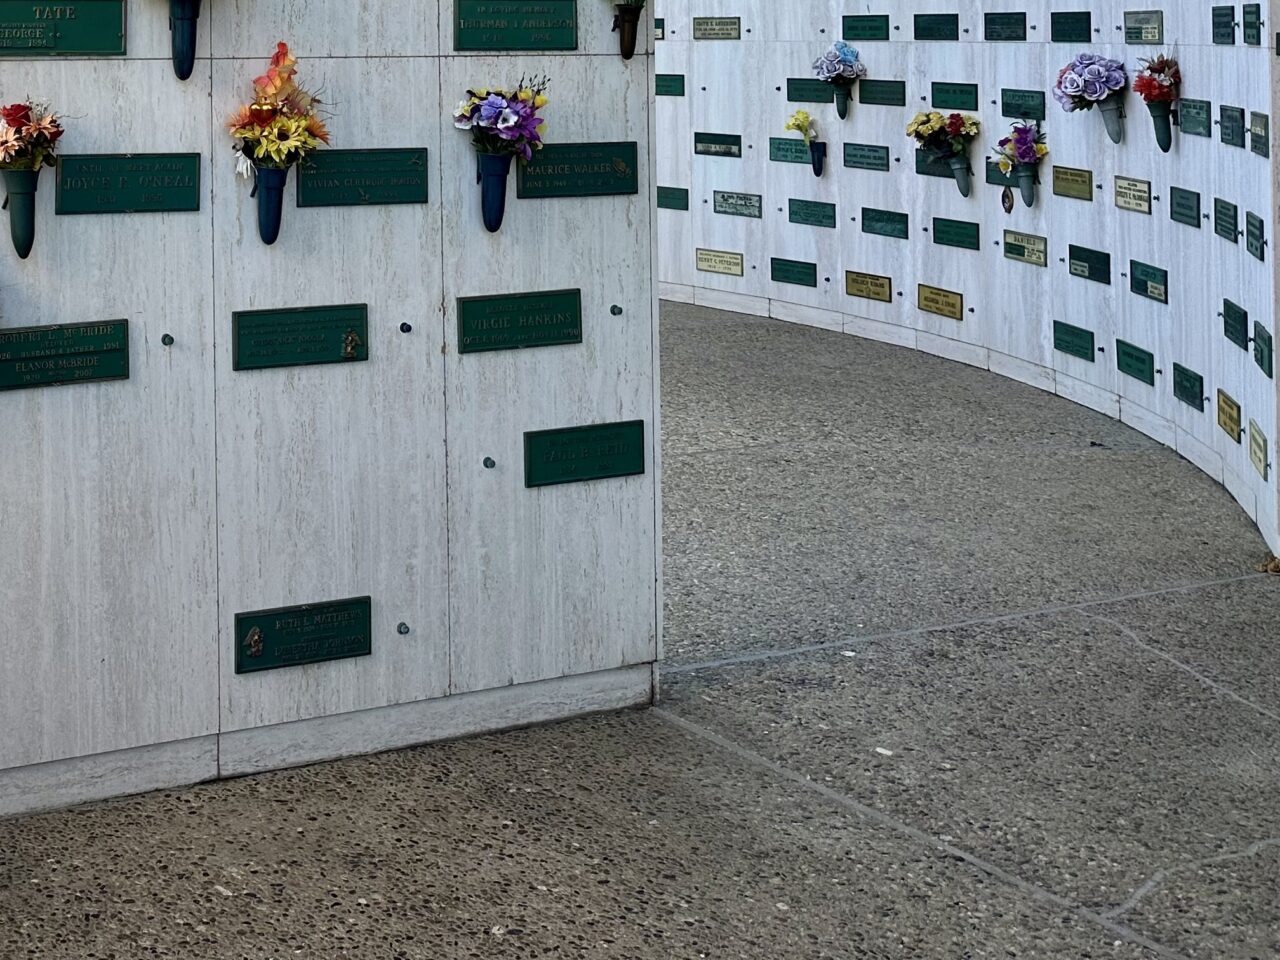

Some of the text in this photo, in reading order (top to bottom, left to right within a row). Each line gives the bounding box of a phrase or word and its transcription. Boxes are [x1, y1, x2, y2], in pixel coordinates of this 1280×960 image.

[32, 6, 76, 19] TATE
[460, 19, 573, 28] THURMAN ANDERSON
[527, 162, 612, 175] MAURICE WALKER
[64, 175, 193, 190] JOYCE O'NEAL
[307, 179, 340, 187] VIVIAN
[1013, 235, 1037, 246] DANIELS
[471, 311, 571, 330] VIRGIE HANKINS
[15, 355, 99, 372] ELANOR McBRIDE
